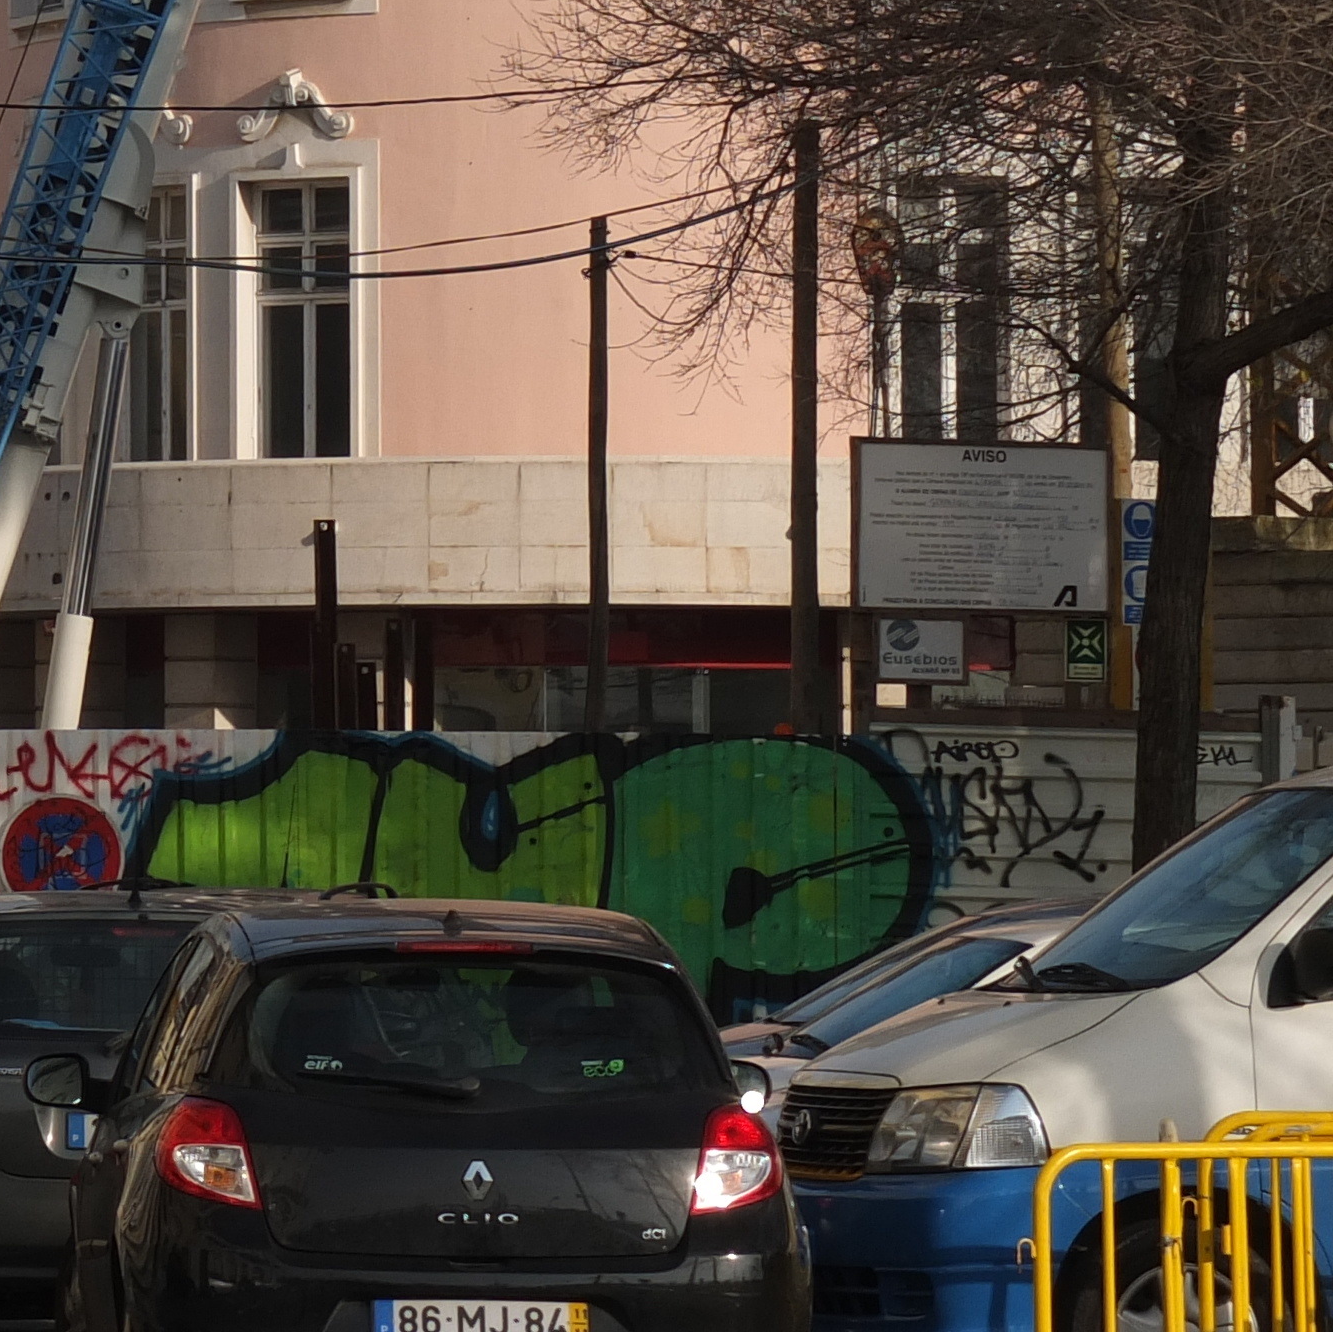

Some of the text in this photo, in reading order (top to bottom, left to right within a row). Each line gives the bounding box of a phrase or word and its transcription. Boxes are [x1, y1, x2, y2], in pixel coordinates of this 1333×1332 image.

[961, 449, 1007, 464] AVISO
[882, 652, 958, 667] Eusébios
[437, 1212, 519, 1224] CLIO
